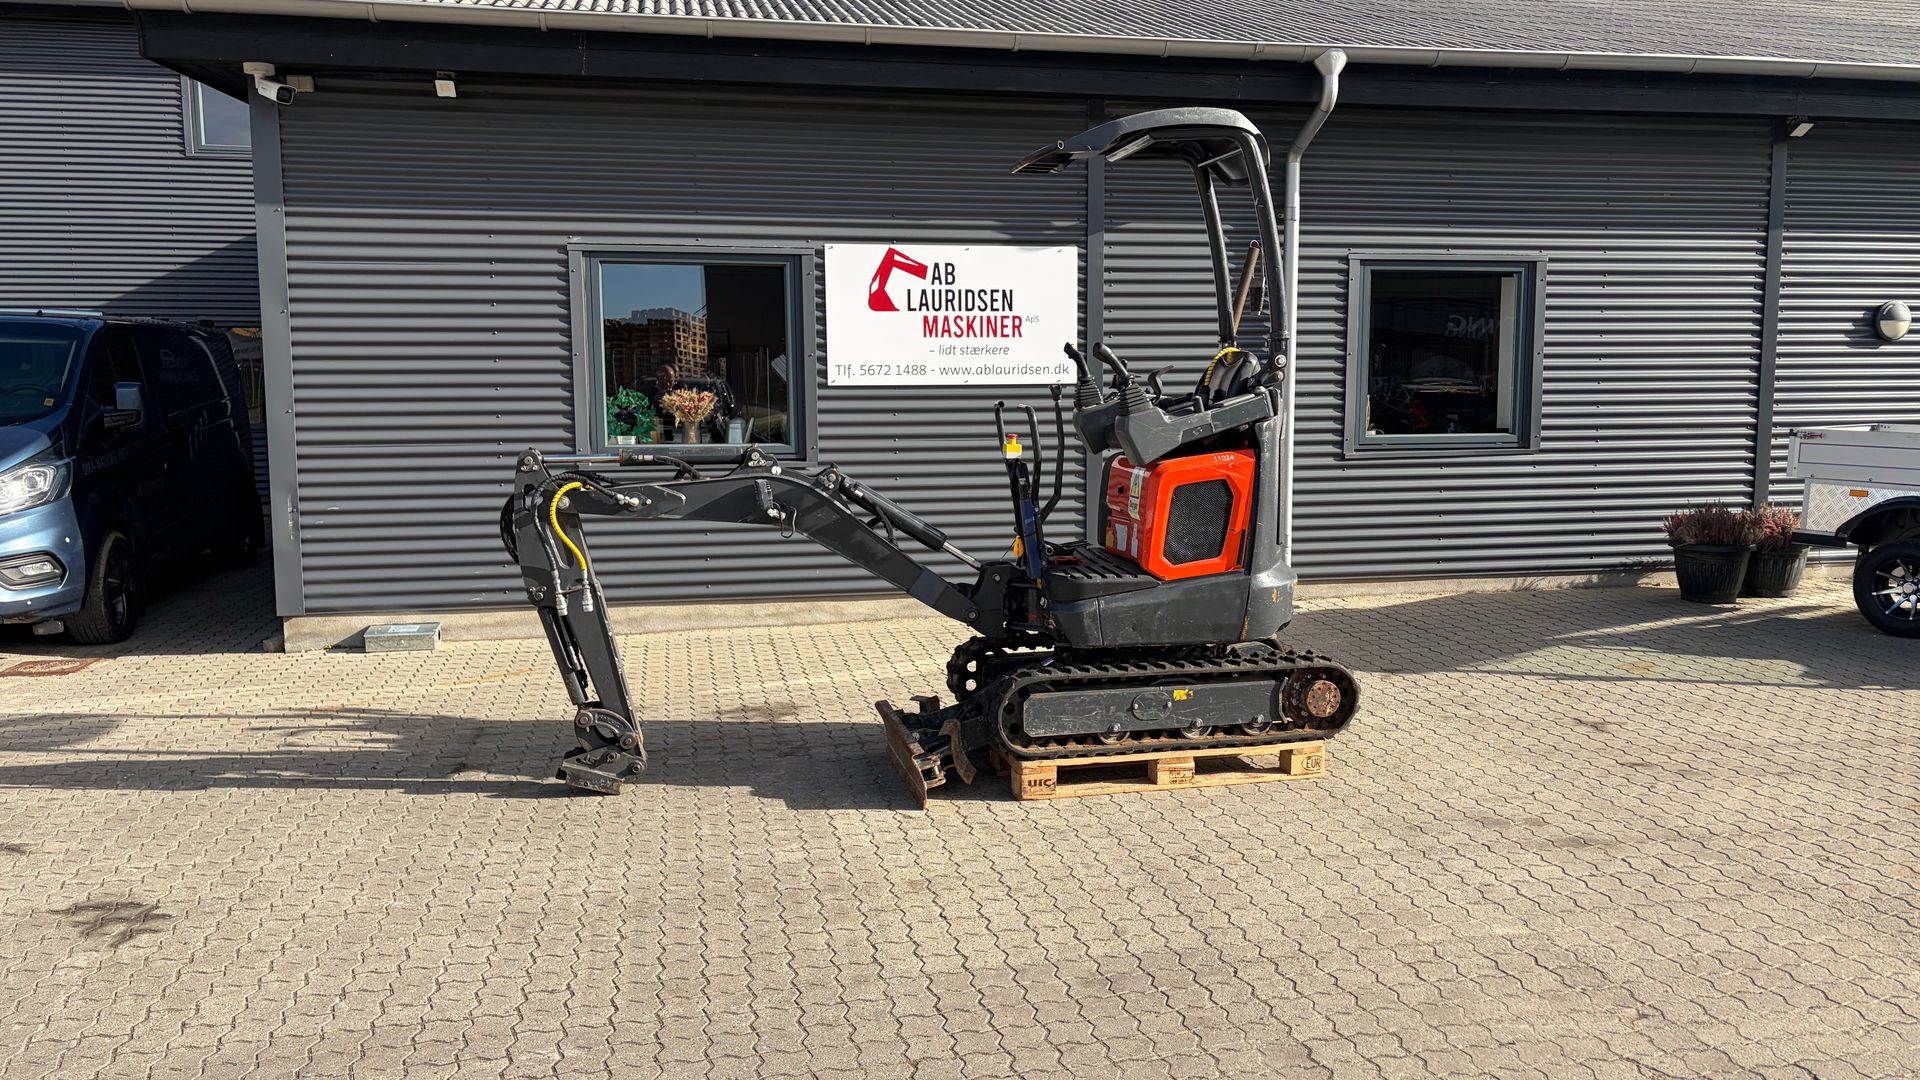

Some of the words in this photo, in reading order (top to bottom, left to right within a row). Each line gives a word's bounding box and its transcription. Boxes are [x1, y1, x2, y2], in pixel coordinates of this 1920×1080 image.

[931, 262, 956, 286] AB
[907, 289, 1014, 312] LAURIDSEN
[923, 315, 1023, 338] MASKINER
[1025, 315, 1040, 324] ApS
[938, 344, 957, 355] lidt
[959, 345, 1010, 355] stærkere
[835, 364, 856, 378] Tlf.
[860, 364, 892, 376] 5672
[895, 364, 927, 376] 1488
[939, 363, 1070, 376] www.ablauridsen.dk
[1306, 757, 1322, 769] EUR
